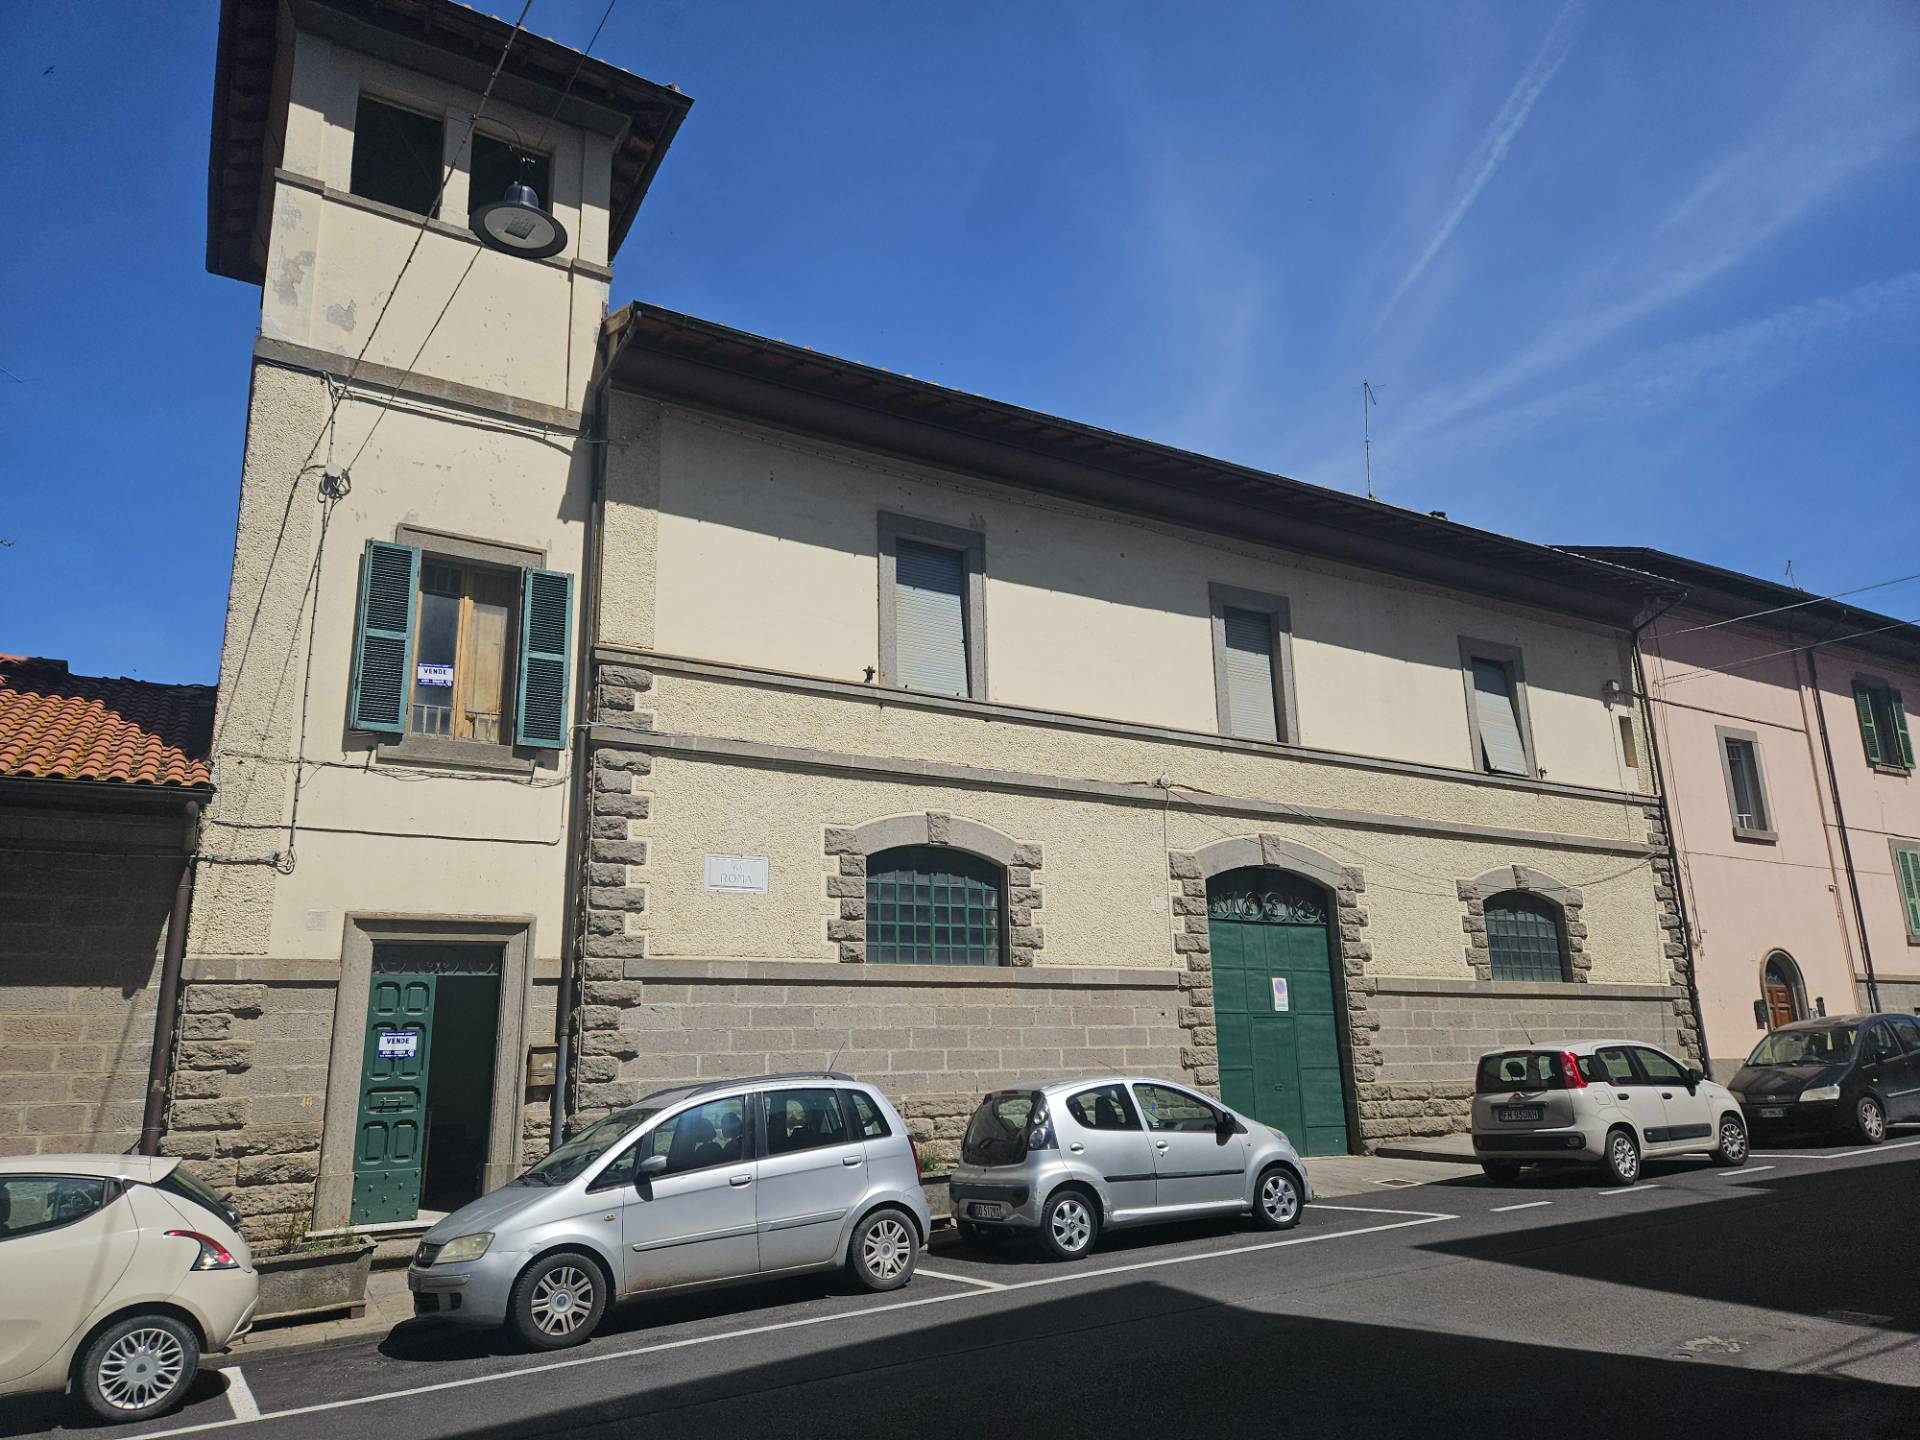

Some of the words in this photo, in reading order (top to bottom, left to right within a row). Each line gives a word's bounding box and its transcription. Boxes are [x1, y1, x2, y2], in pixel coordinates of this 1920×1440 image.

[423, 667, 448, 675] VENDE
[720, 872, 753, 884] ROMA
[386, 1037, 411, 1045] VENDE
